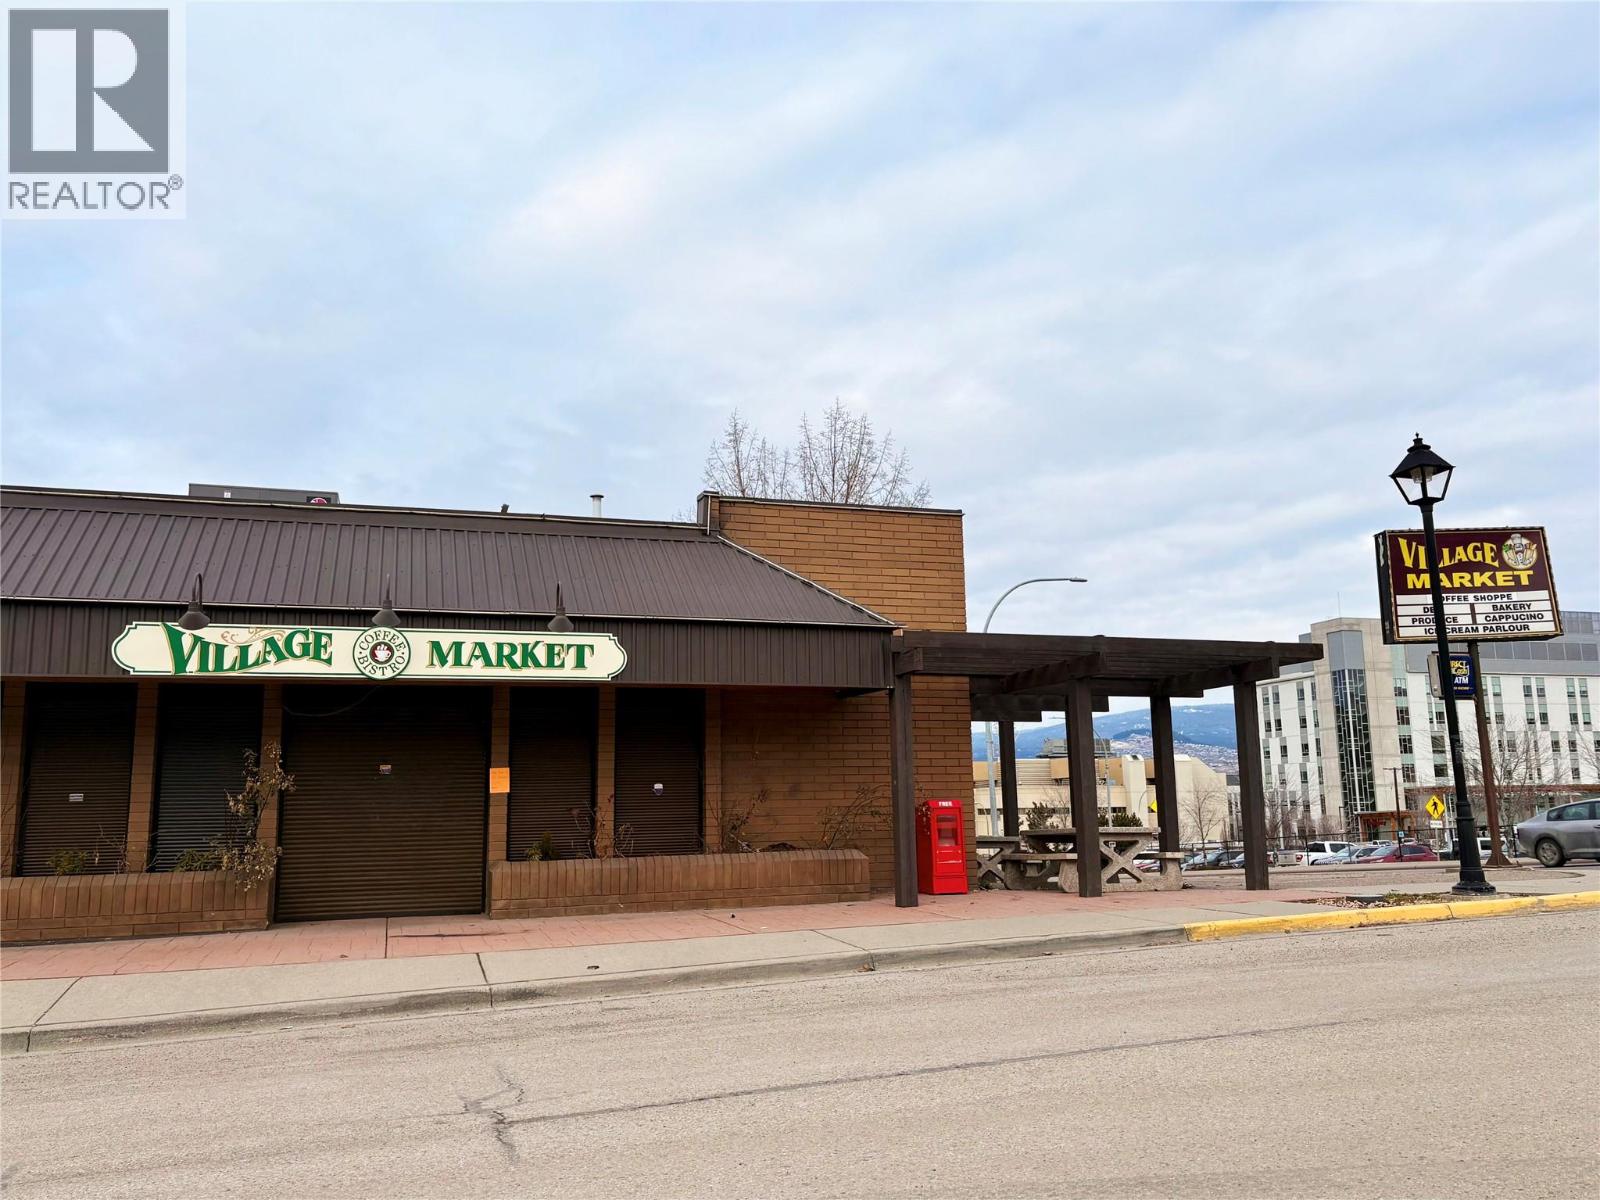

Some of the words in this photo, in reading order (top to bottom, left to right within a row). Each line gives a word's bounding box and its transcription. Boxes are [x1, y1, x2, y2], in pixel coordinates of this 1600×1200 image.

[1397, 536, 1500, 569] VILAGE
[1473, 593, 1513, 602] SHOPPE
[1492, 603, 1532, 611] BAKERY
[1484, 612, 1545, 622] CAPPUCINO
[1445, 625, 1480, 635] CREAM
[1482, 623, 1530, 633] PARLOUR
[161, 622, 333, 675] VILLAGE
[425, 640, 595, 671] MARKET
[359, 630, 406, 651] COFFEE
[357, 655, 406, 676] BISTRO
